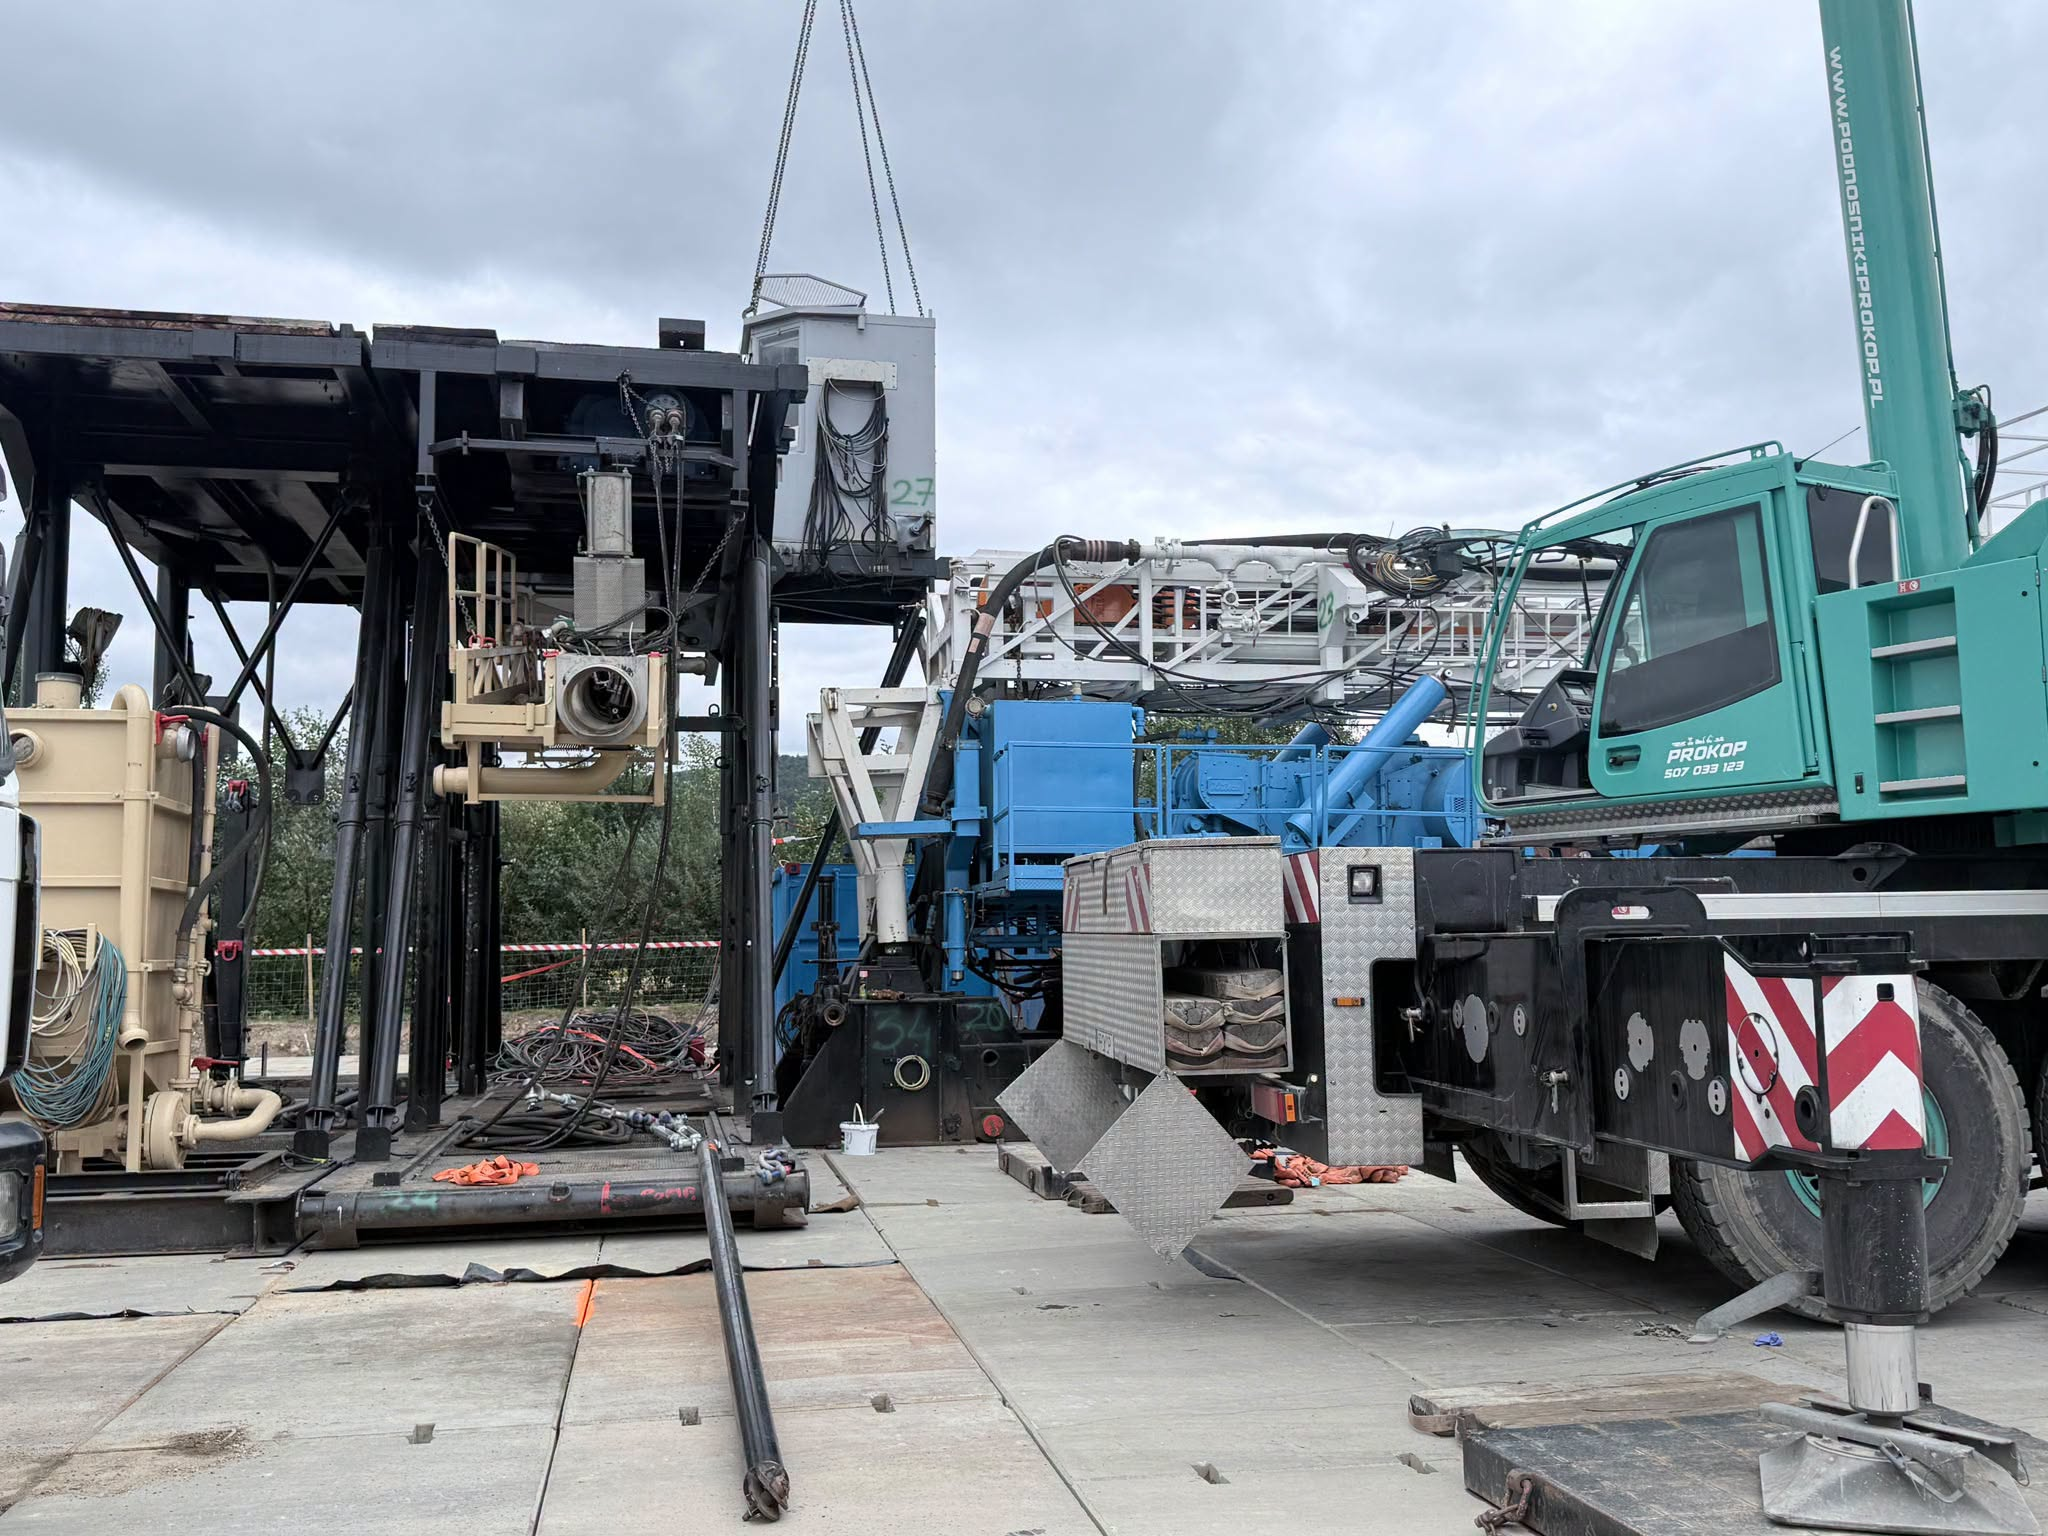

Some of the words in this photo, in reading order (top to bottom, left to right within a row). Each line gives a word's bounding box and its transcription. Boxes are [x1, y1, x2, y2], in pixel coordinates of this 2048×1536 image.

[1830, 46, 1884, 408] WWW.PODNOSNIKIPROKOP.PL
[890, 477, 935, 506] 27
[1319, 591, 1334, 629] 23
[1666, 740, 1748, 764] PROKOP
[1663, 767, 1690, 779] 507
[1692, 763, 1719, 776] 033
[1722, 760, 1745, 773] 123
[964, 1003, 1005, 1032] 20
